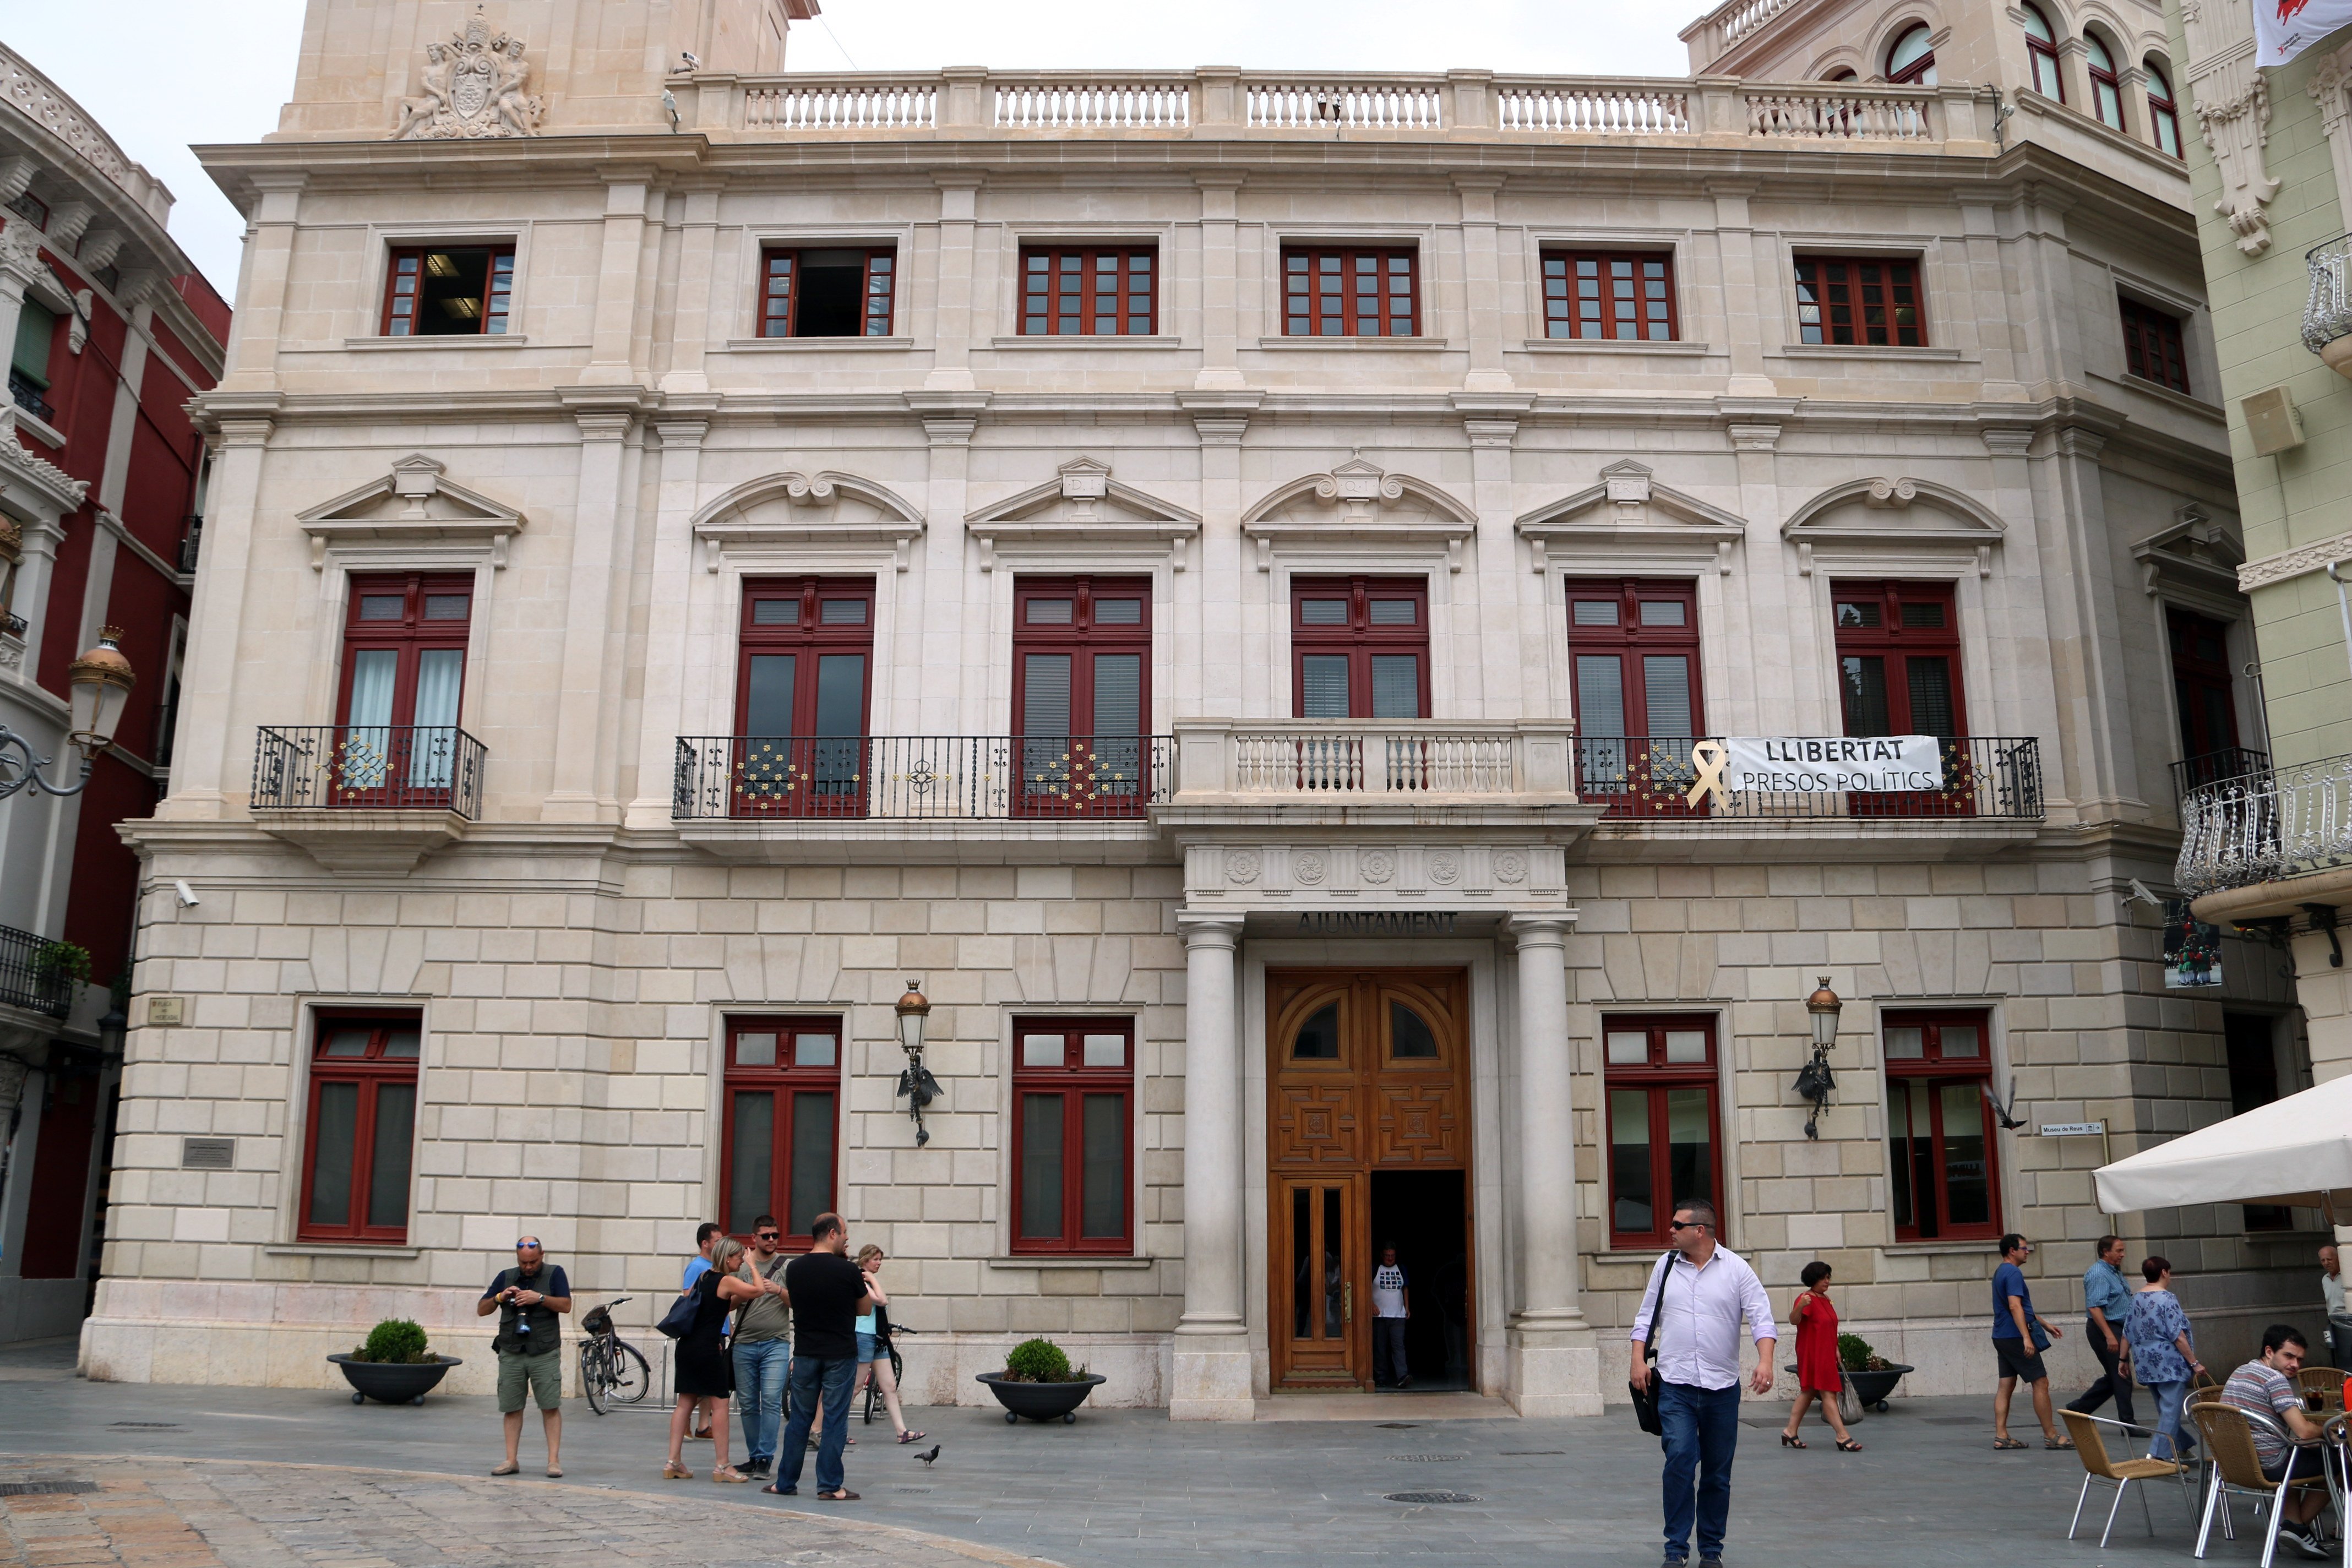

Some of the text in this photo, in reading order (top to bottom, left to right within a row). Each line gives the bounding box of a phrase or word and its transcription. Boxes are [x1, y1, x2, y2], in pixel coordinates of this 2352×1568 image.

[1766, 740, 1903, 762] LLIBERTAT
[1744, 767, 1934, 791] PRESOS POLÍTICS
[1297, 912, 1458, 933] AJUNTAMENT
